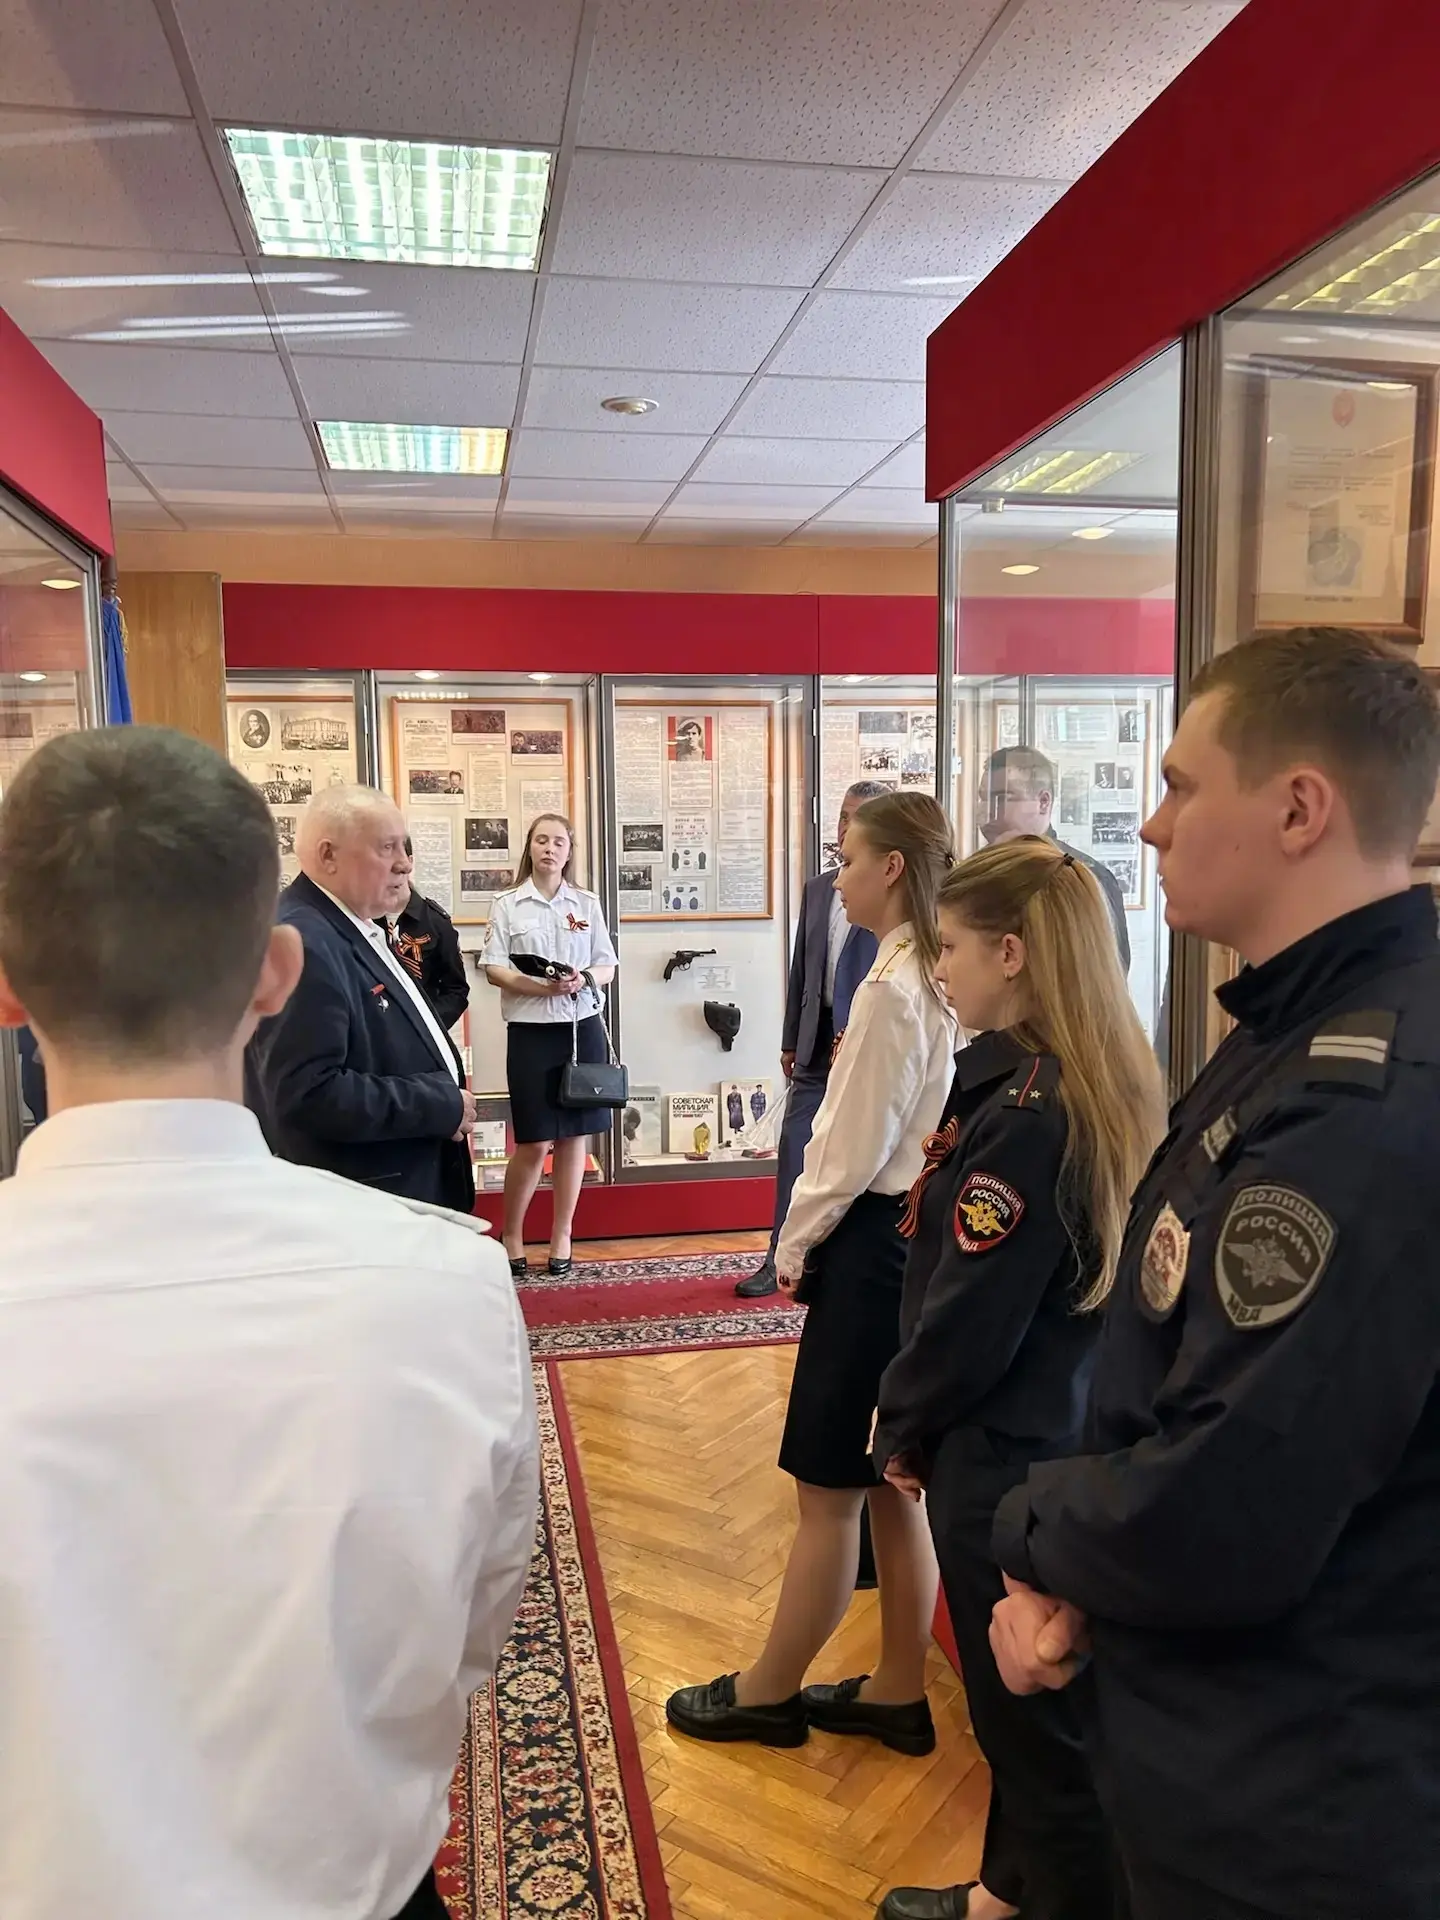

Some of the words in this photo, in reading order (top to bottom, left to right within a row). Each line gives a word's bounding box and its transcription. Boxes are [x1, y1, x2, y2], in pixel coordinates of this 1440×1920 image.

[970, 1188, 1010, 1219] РОССИЯ
[971, 1176, 1022, 1212] ПОЛИЦИЯ
[1239, 1191, 1328, 1245] ПОЛИЦИЯ
[958, 1232, 979, 1251] МВД
[1235, 1215, 1311, 1264] РОССИЯ
[1227, 1293, 1262, 1323] МВД
